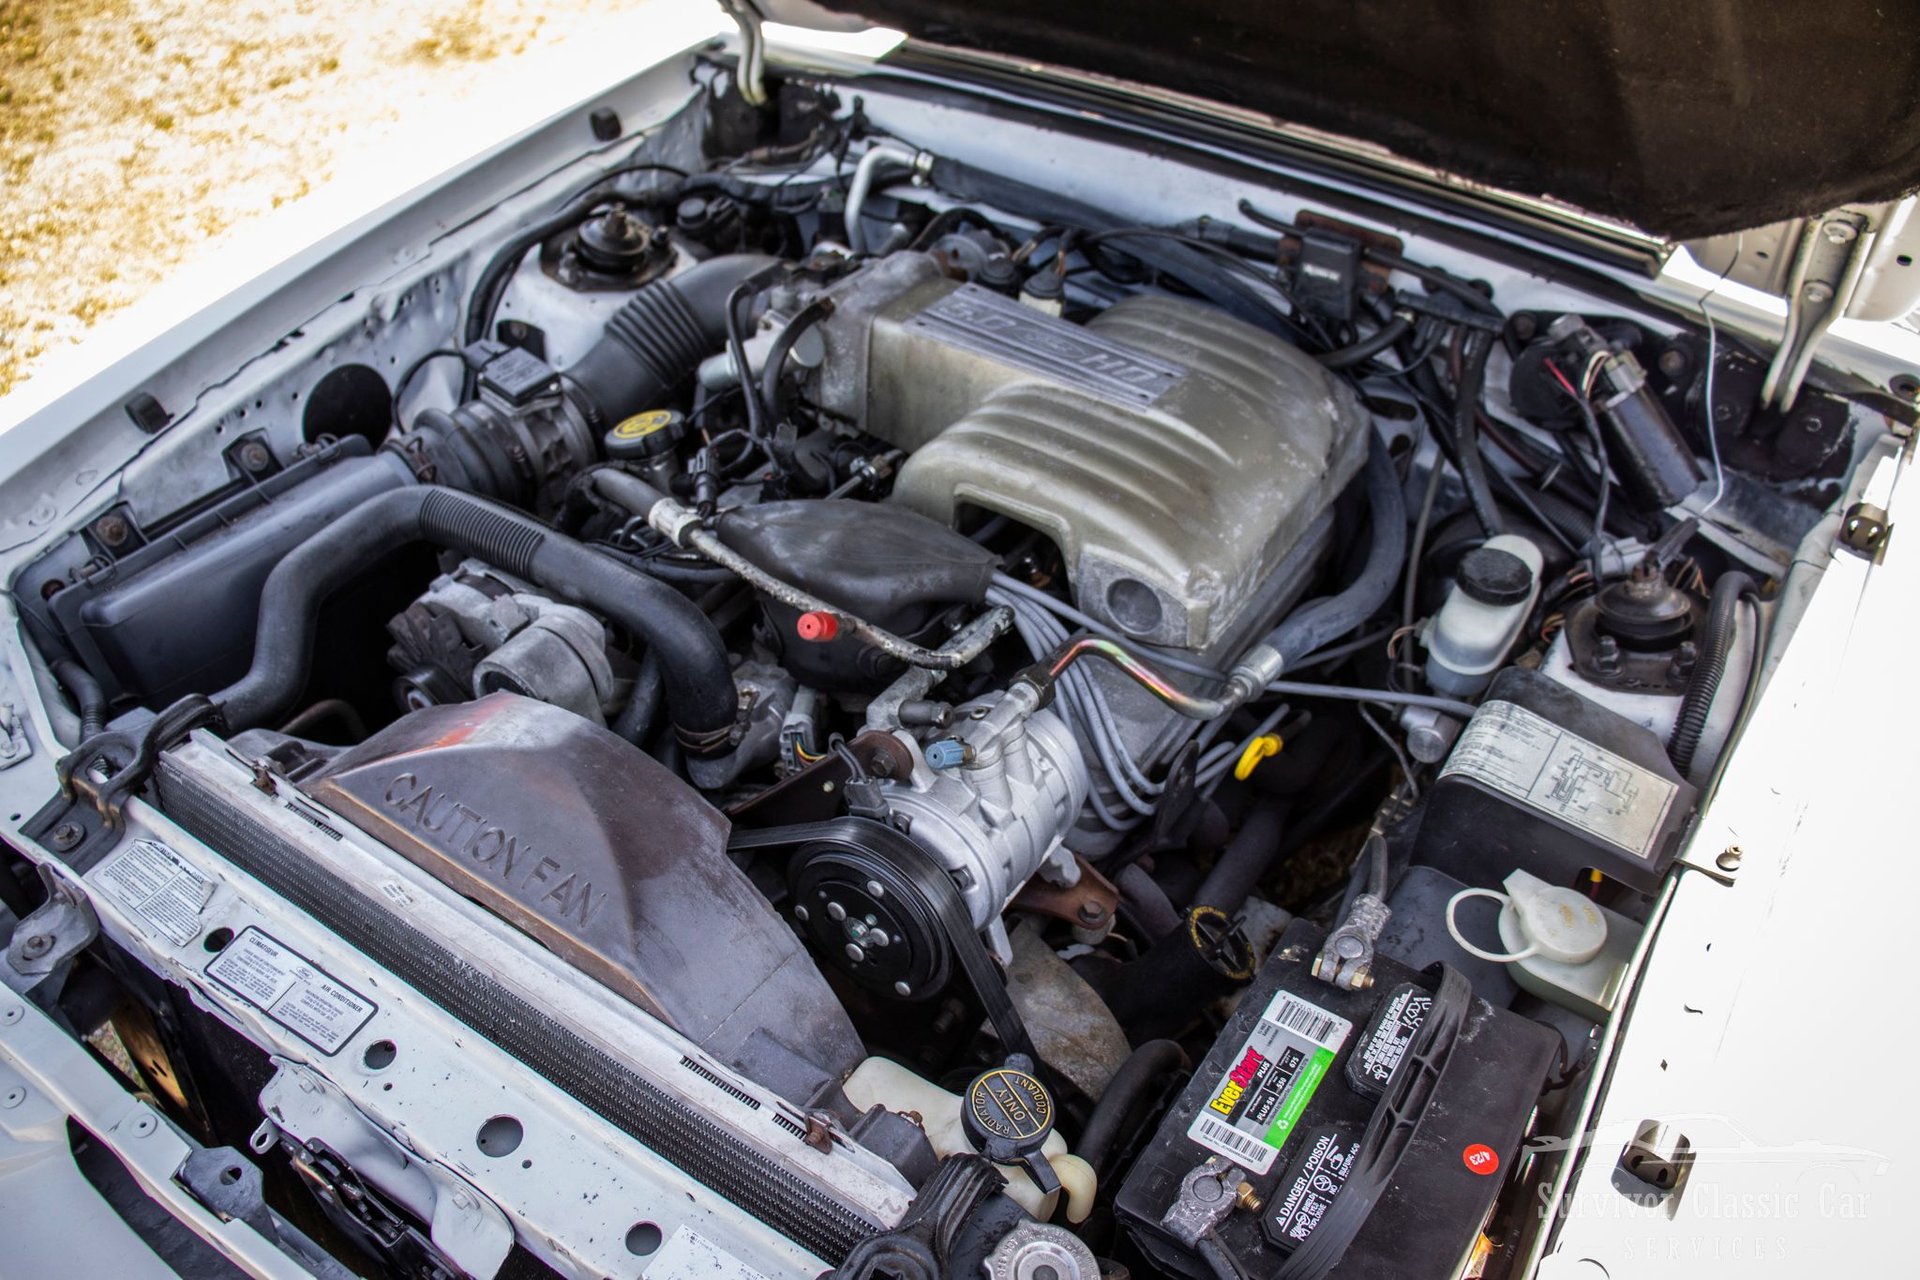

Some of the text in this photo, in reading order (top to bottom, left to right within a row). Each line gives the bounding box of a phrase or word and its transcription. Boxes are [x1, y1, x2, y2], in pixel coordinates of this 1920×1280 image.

[1081, 353, 1157, 382] HO
[385, 773, 607, 928] CAUTION FAN
[320, 984, 333, 994] AIR
[331, 989, 363, 1013] CONDITIONER
[1257, 1061, 1270, 1078] PLUS
[1289, 1056, 1299, 1068] 675
[1013, 1076, 1046, 1114] COOLANT
[1209, 1046, 1264, 1115] EverStart
[1276, 1077, 1287, 1089] 550
[974, 1091, 1010, 1135] RADIATOR
[996, 1089, 1025, 1121] ONLY
[1338, 1153, 1354, 1176] SULFURIC
[1471, 1150, 1491, 1165] 4/23
[1280, 1176, 1307, 1216] DANGER
[1305, 1135, 1330, 1170] POISON
[1328, 1184, 1338, 1194] NO
[1308, 1201, 1319, 1215] EYES
